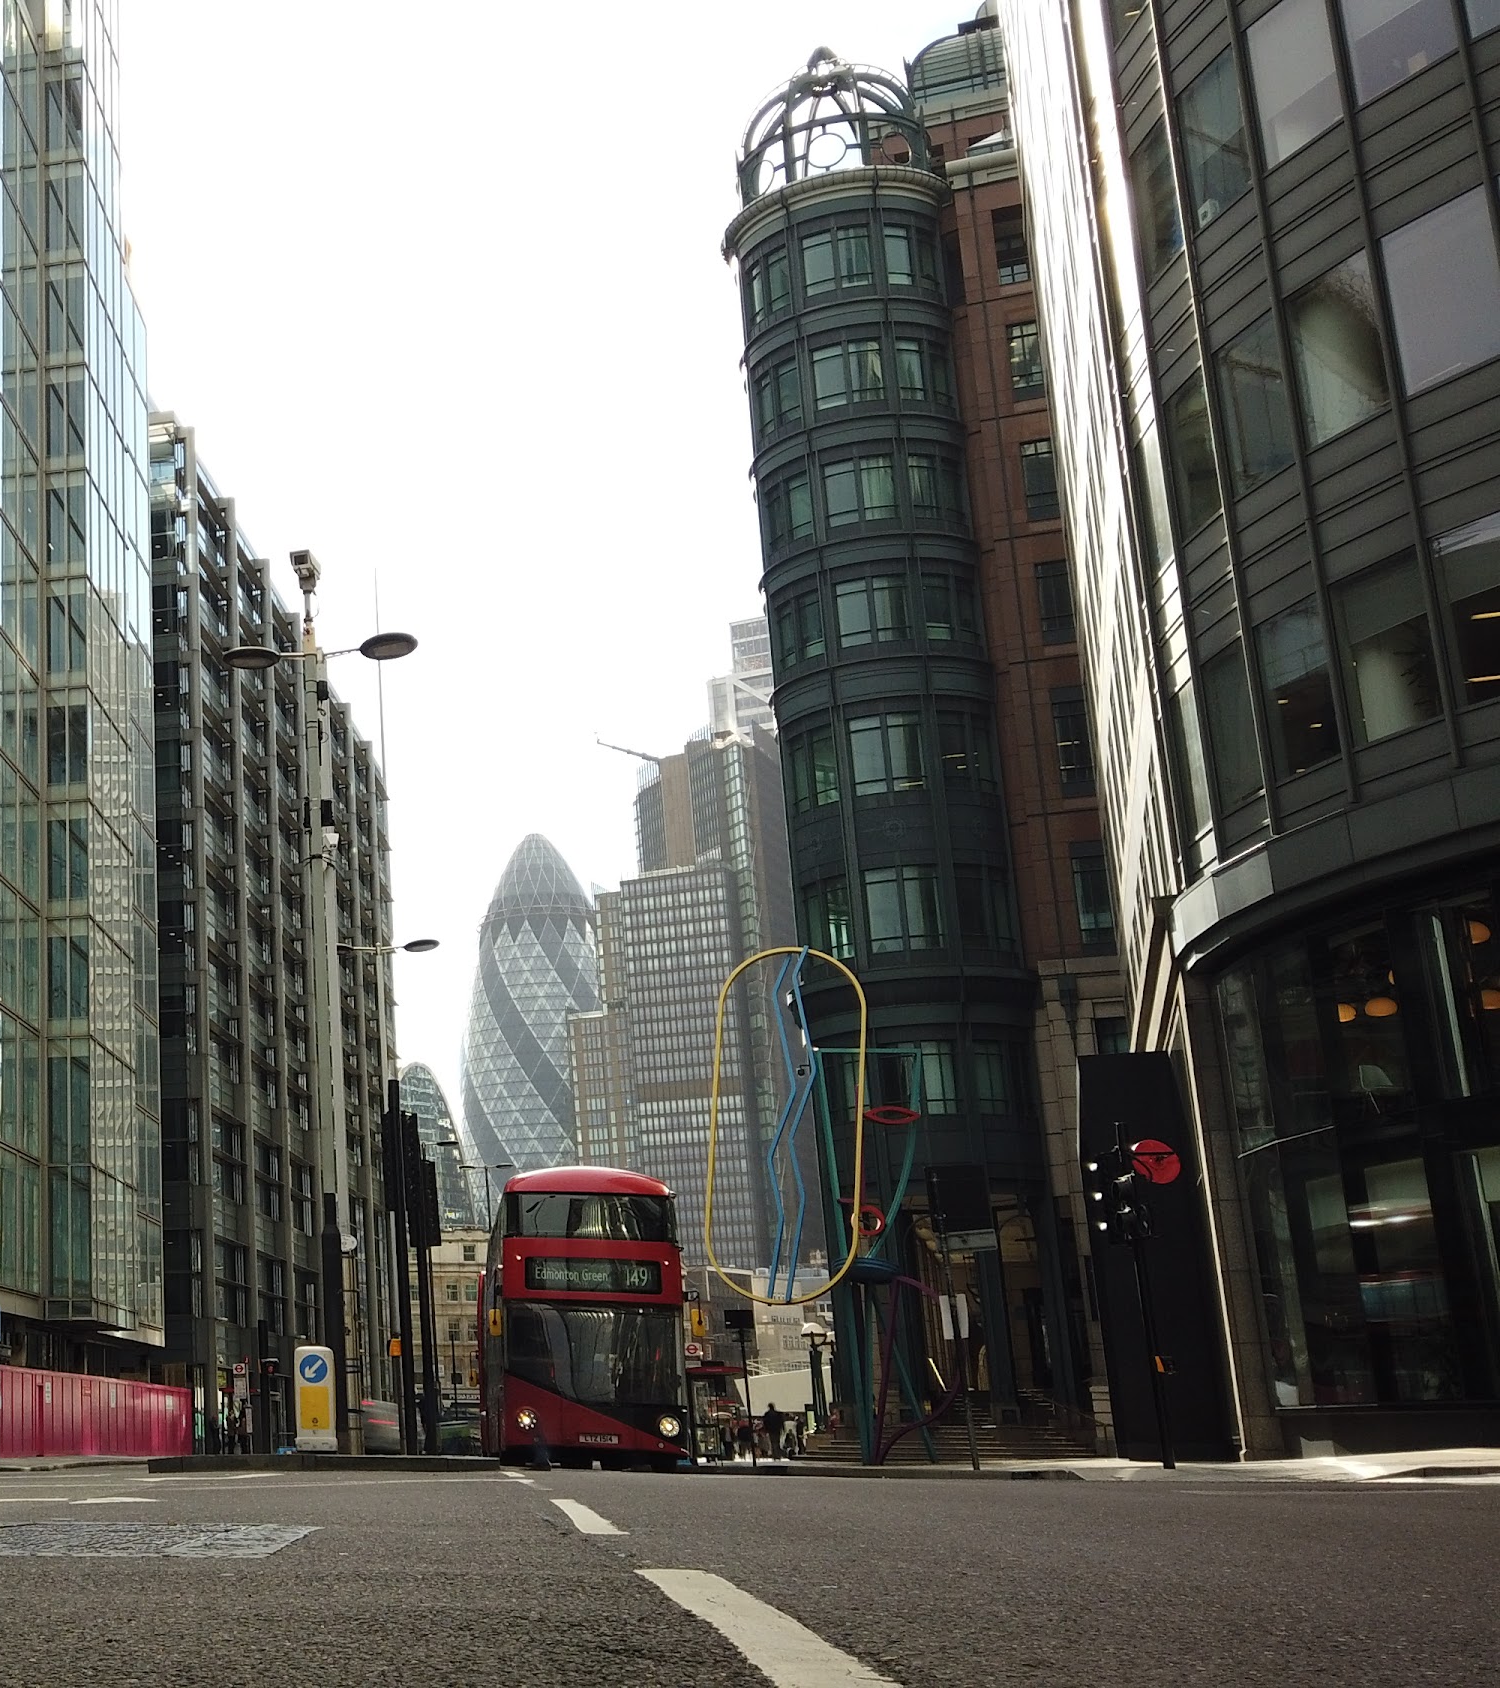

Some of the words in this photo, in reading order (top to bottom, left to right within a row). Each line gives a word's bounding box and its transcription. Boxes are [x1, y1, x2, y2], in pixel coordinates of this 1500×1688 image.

[535, 1266, 579, 1281] Edmonton
[582, 1268, 608, 1282] Green
[625, 1267, 648, 1287] 149
